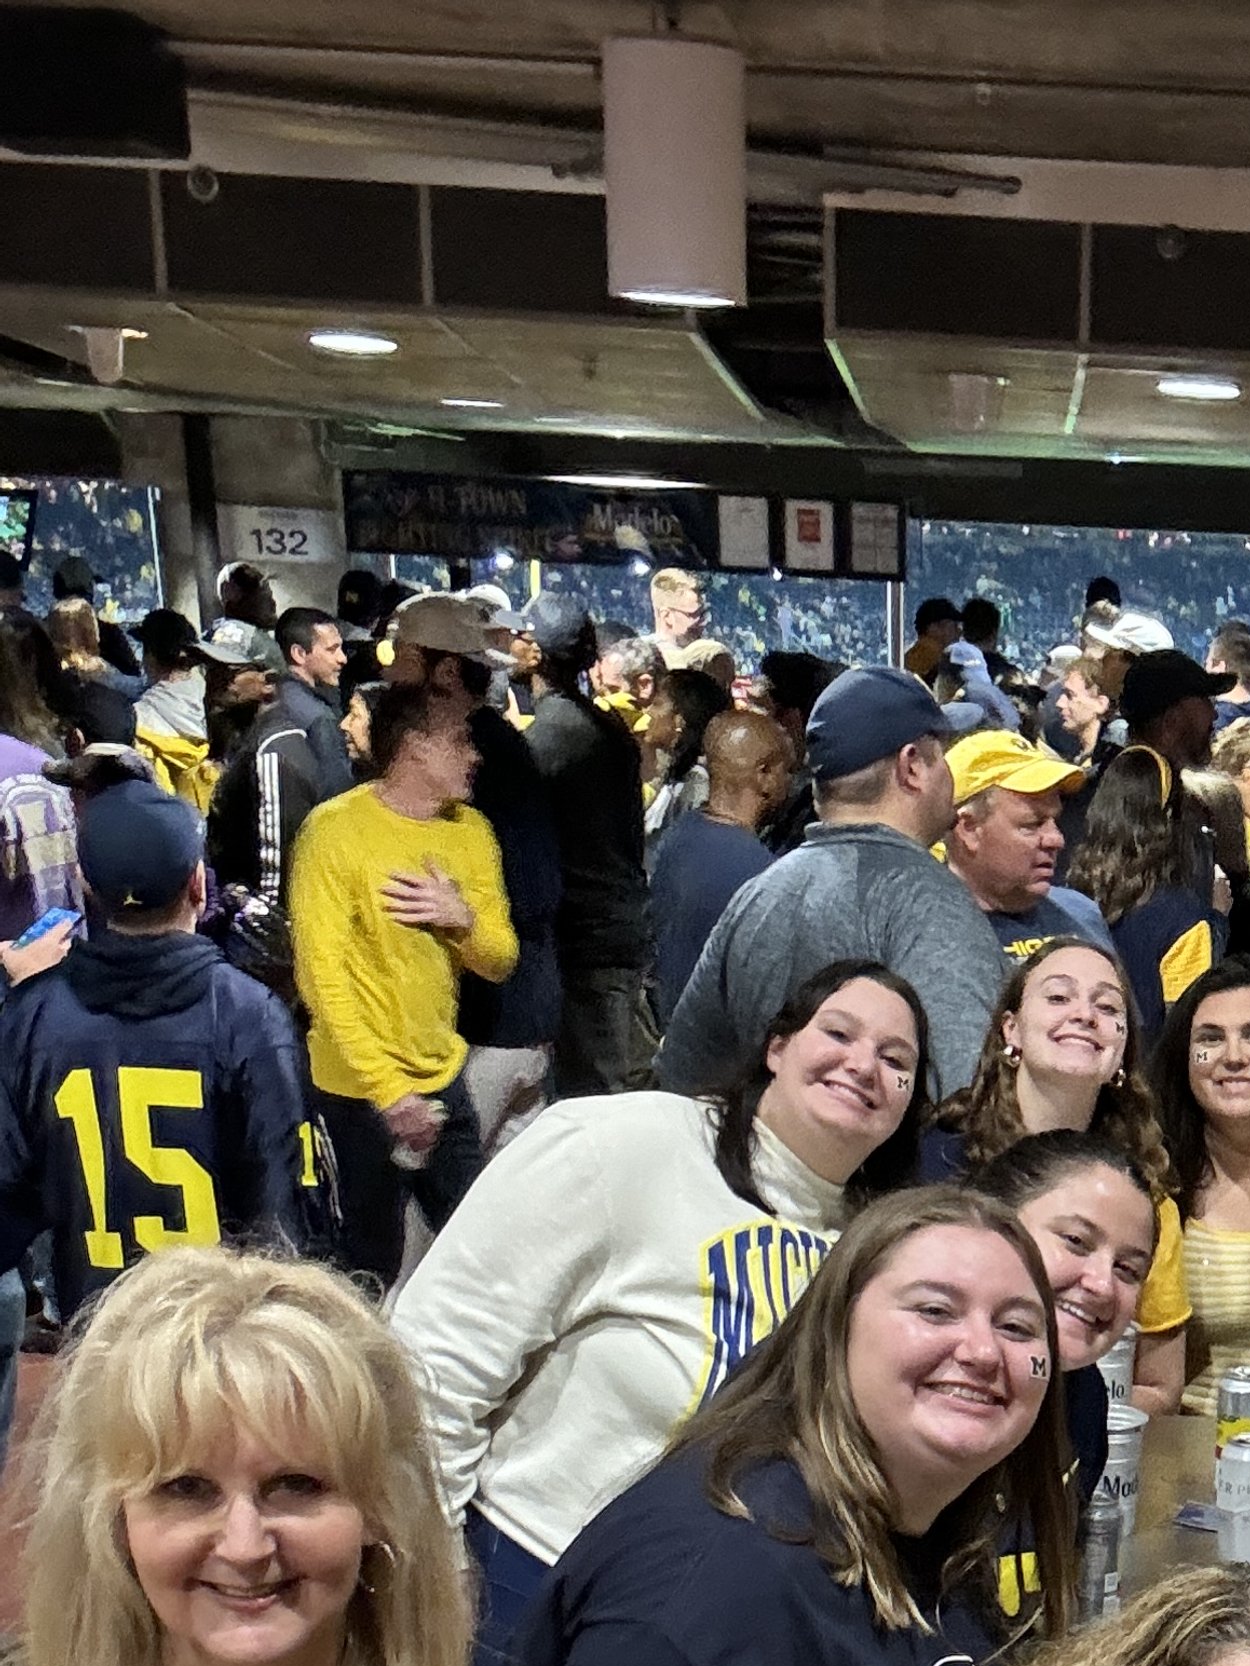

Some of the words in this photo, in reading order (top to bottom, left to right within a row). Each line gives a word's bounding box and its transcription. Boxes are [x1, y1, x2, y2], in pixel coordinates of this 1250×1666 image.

[250, 528, 309, 555] 132
[54, 1066, 221, 1269] 15
[1030, 1356, 1047, 1377] M
